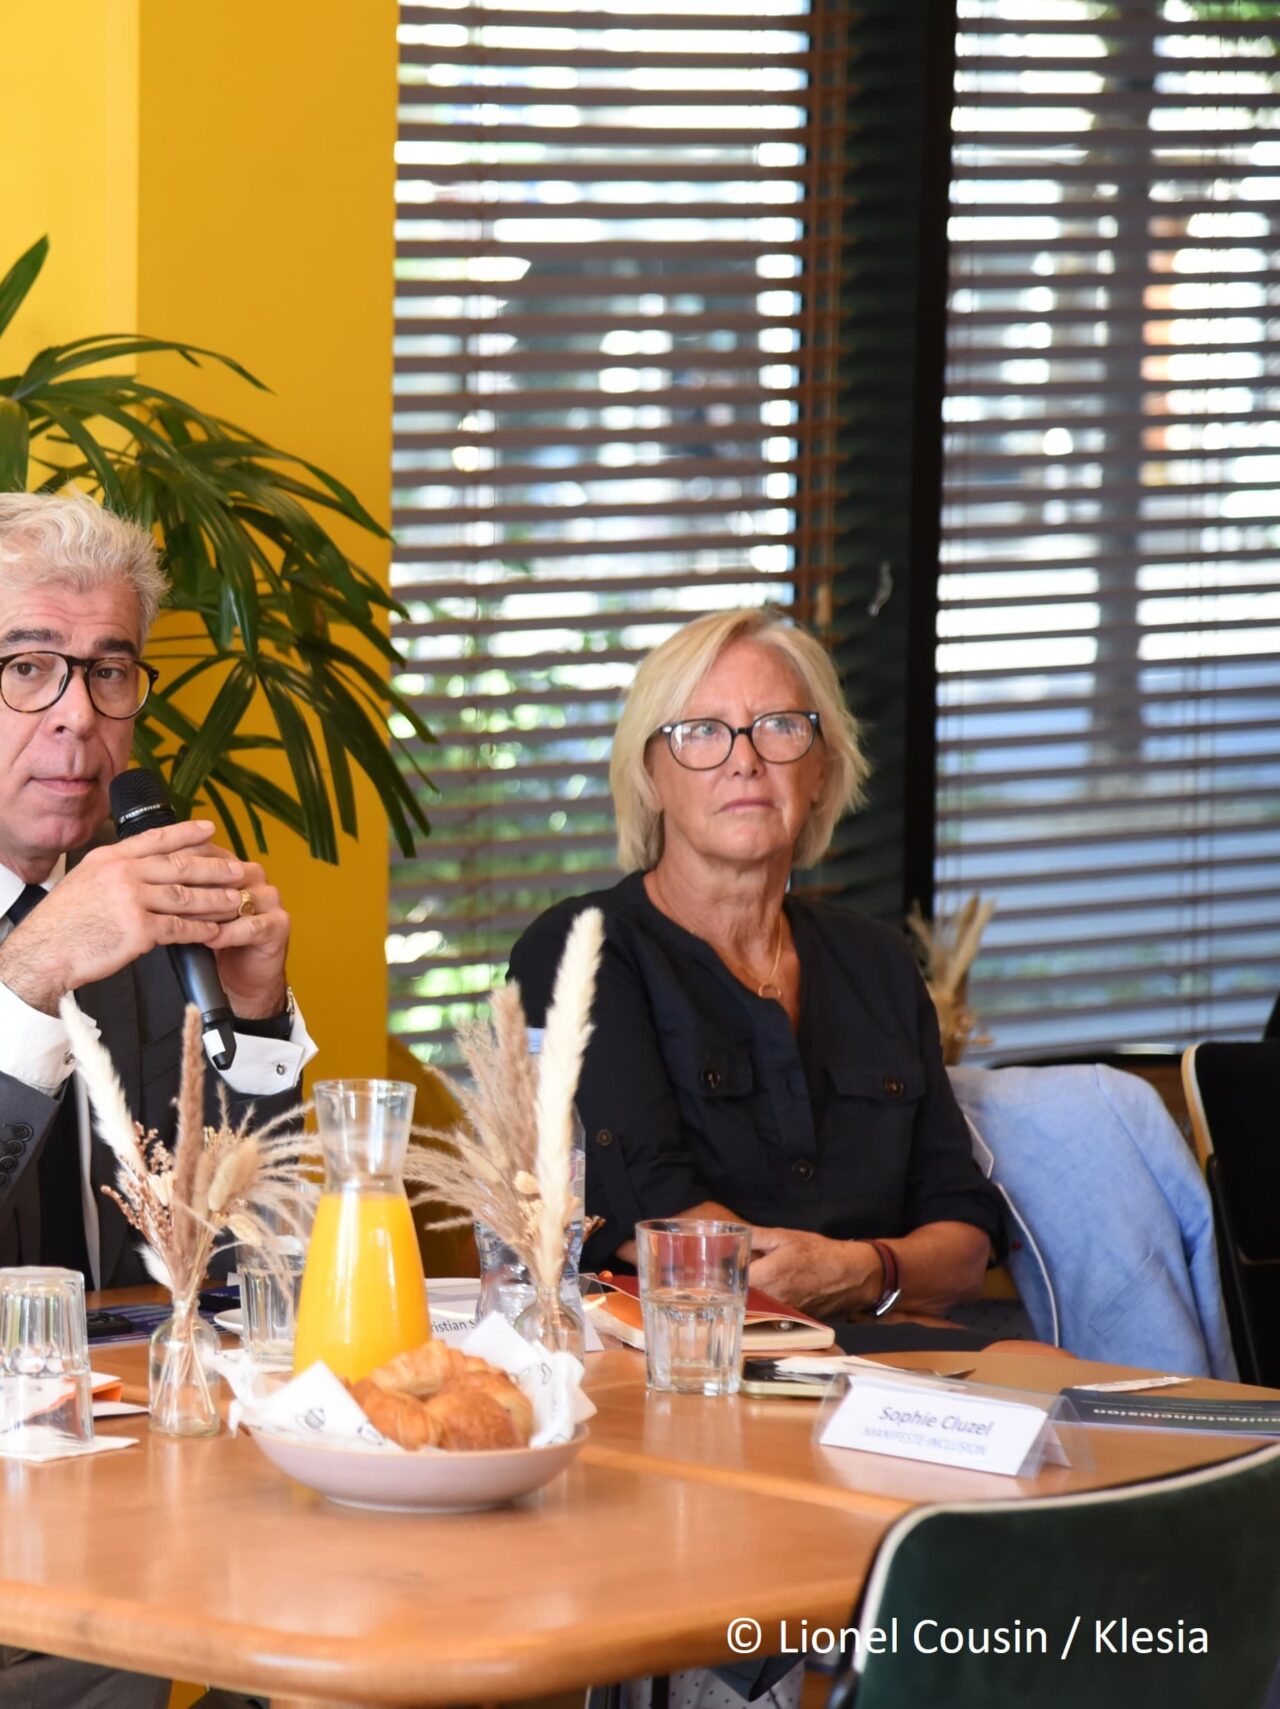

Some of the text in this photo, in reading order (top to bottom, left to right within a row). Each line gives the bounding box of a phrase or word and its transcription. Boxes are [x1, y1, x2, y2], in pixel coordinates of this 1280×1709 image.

[431, 1319, 468, 1333] ristian
[879, 1406, 994, 1437] Sophie Cluzel
